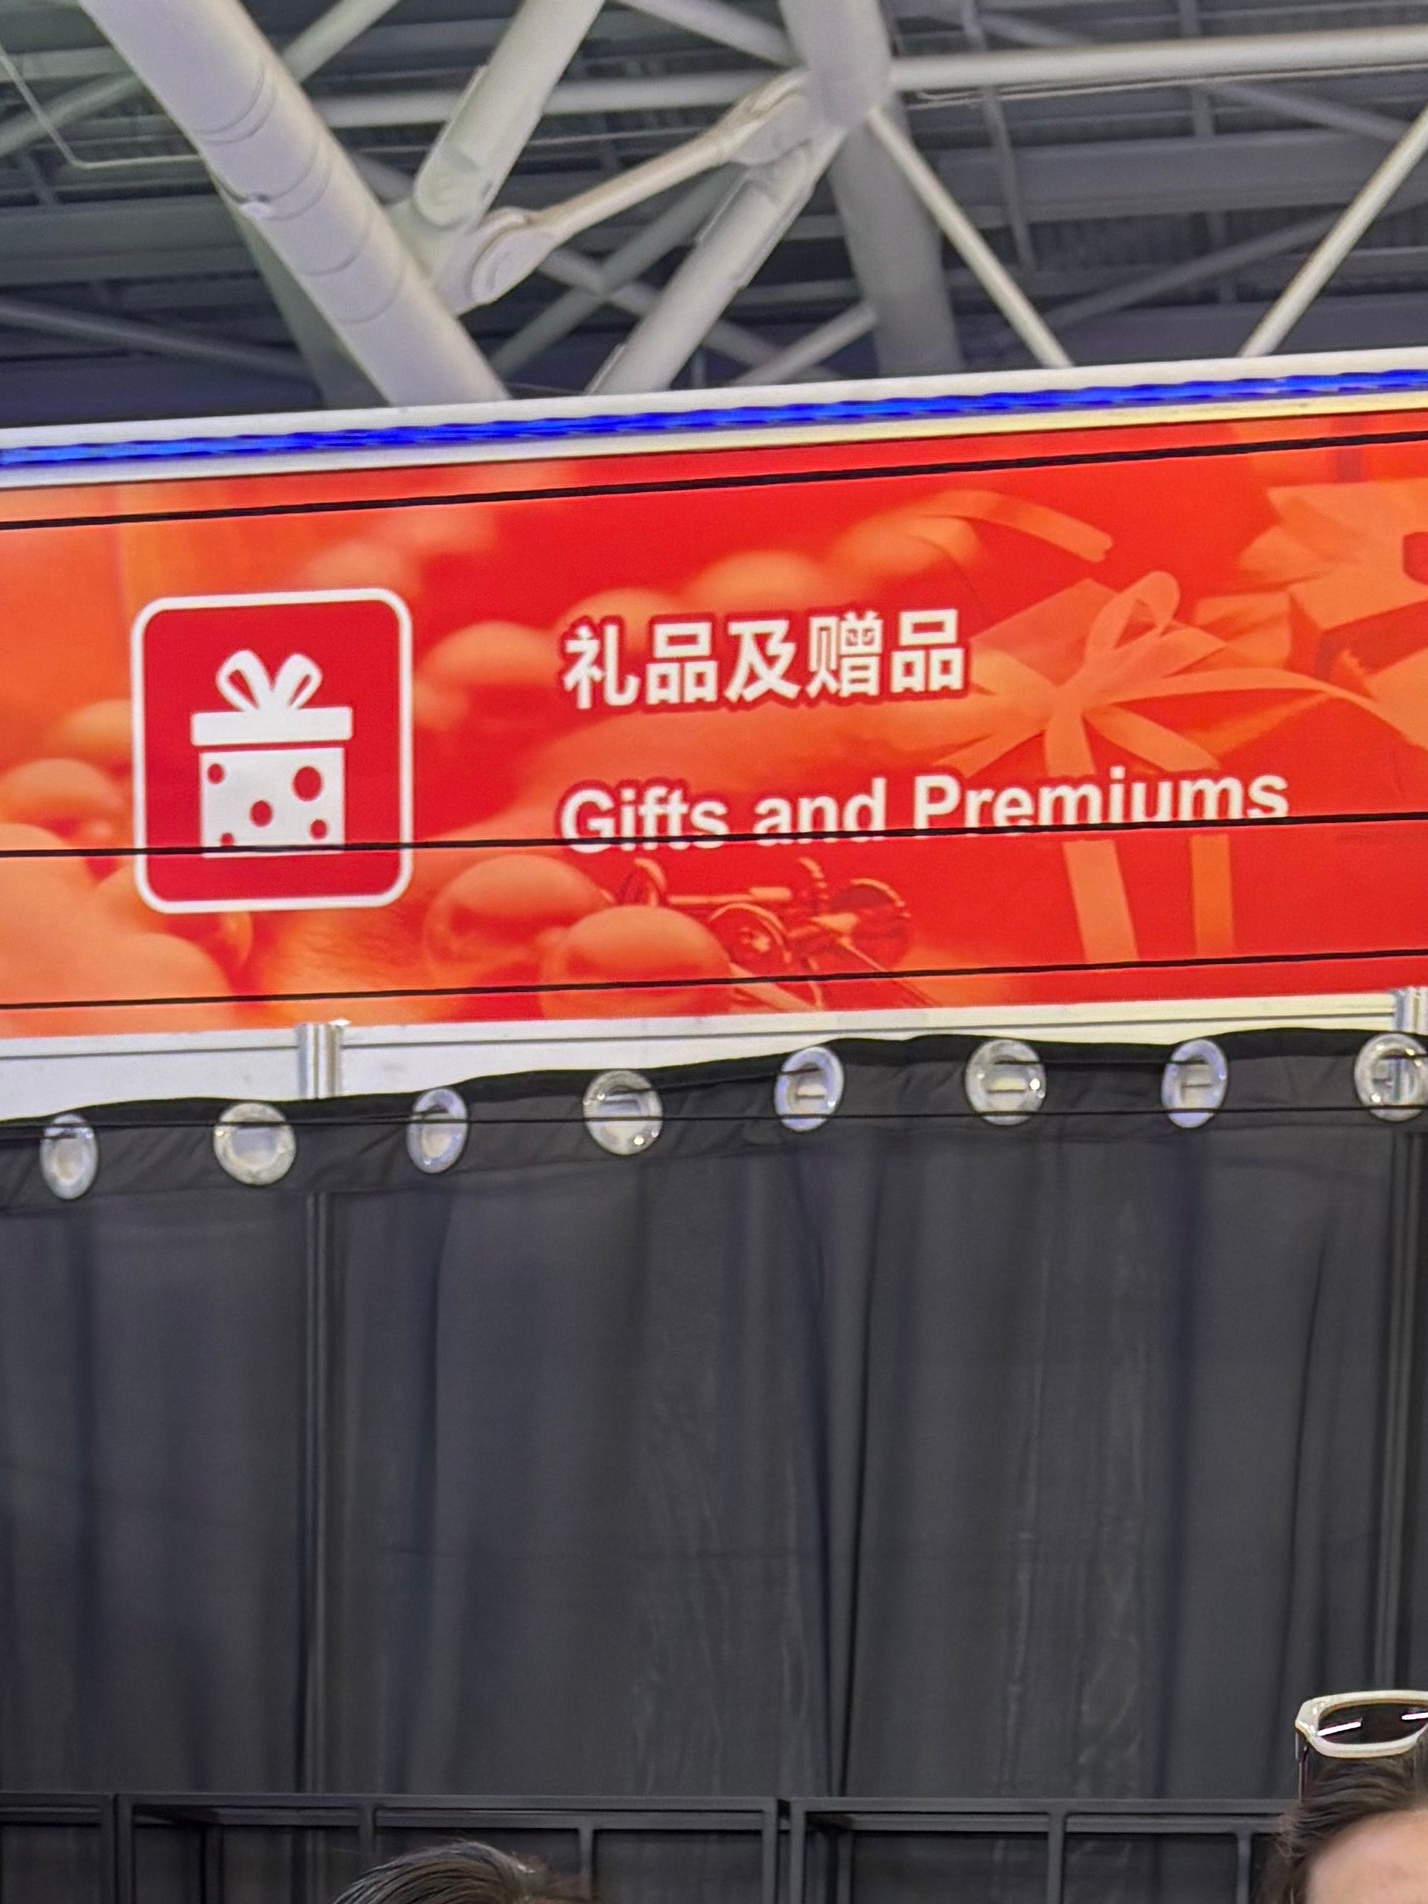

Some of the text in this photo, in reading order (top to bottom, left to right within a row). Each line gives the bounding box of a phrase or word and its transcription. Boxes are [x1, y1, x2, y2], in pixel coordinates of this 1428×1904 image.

[562, 608, 968, 710] 礼品及赠品
[561, 766, 1290, 854] Gifts and Premiums
